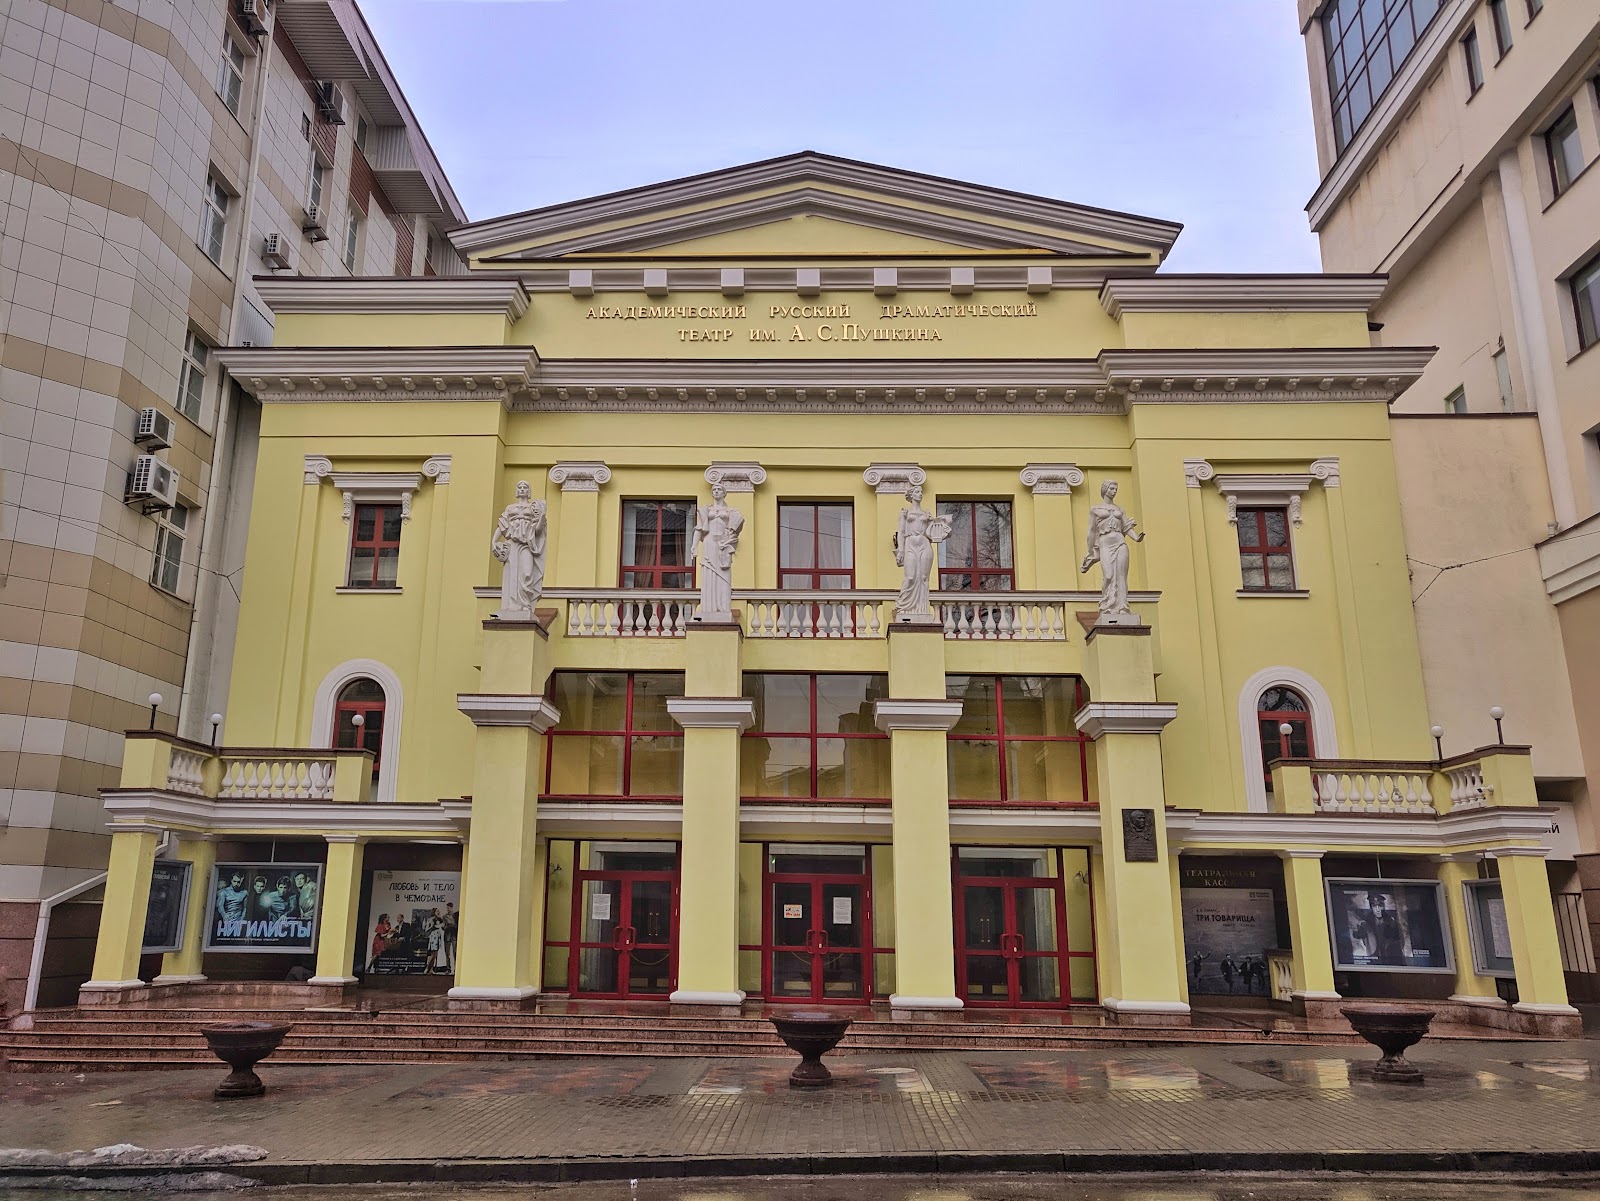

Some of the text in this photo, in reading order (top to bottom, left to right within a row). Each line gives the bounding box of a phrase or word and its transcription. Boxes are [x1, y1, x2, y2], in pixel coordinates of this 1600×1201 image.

[586, 302, 1038, 320] АКАДЕМИЧЕСКИЙ РУССКИЙ ДРАМАТИЧЕСКИЙ
[678, 328, 734, 342] ТЕАТР
[389, 882, 455, 891] ЛЮБОВЬ И ТЕЛО
[395, 894, 446, 903] В ЧЕМОДАНЕ
[1196, 914, 1256, 923] ТРИ ТОВАРИЩА
[216, 920, 313, 938] НИГИЛИСТЫ
